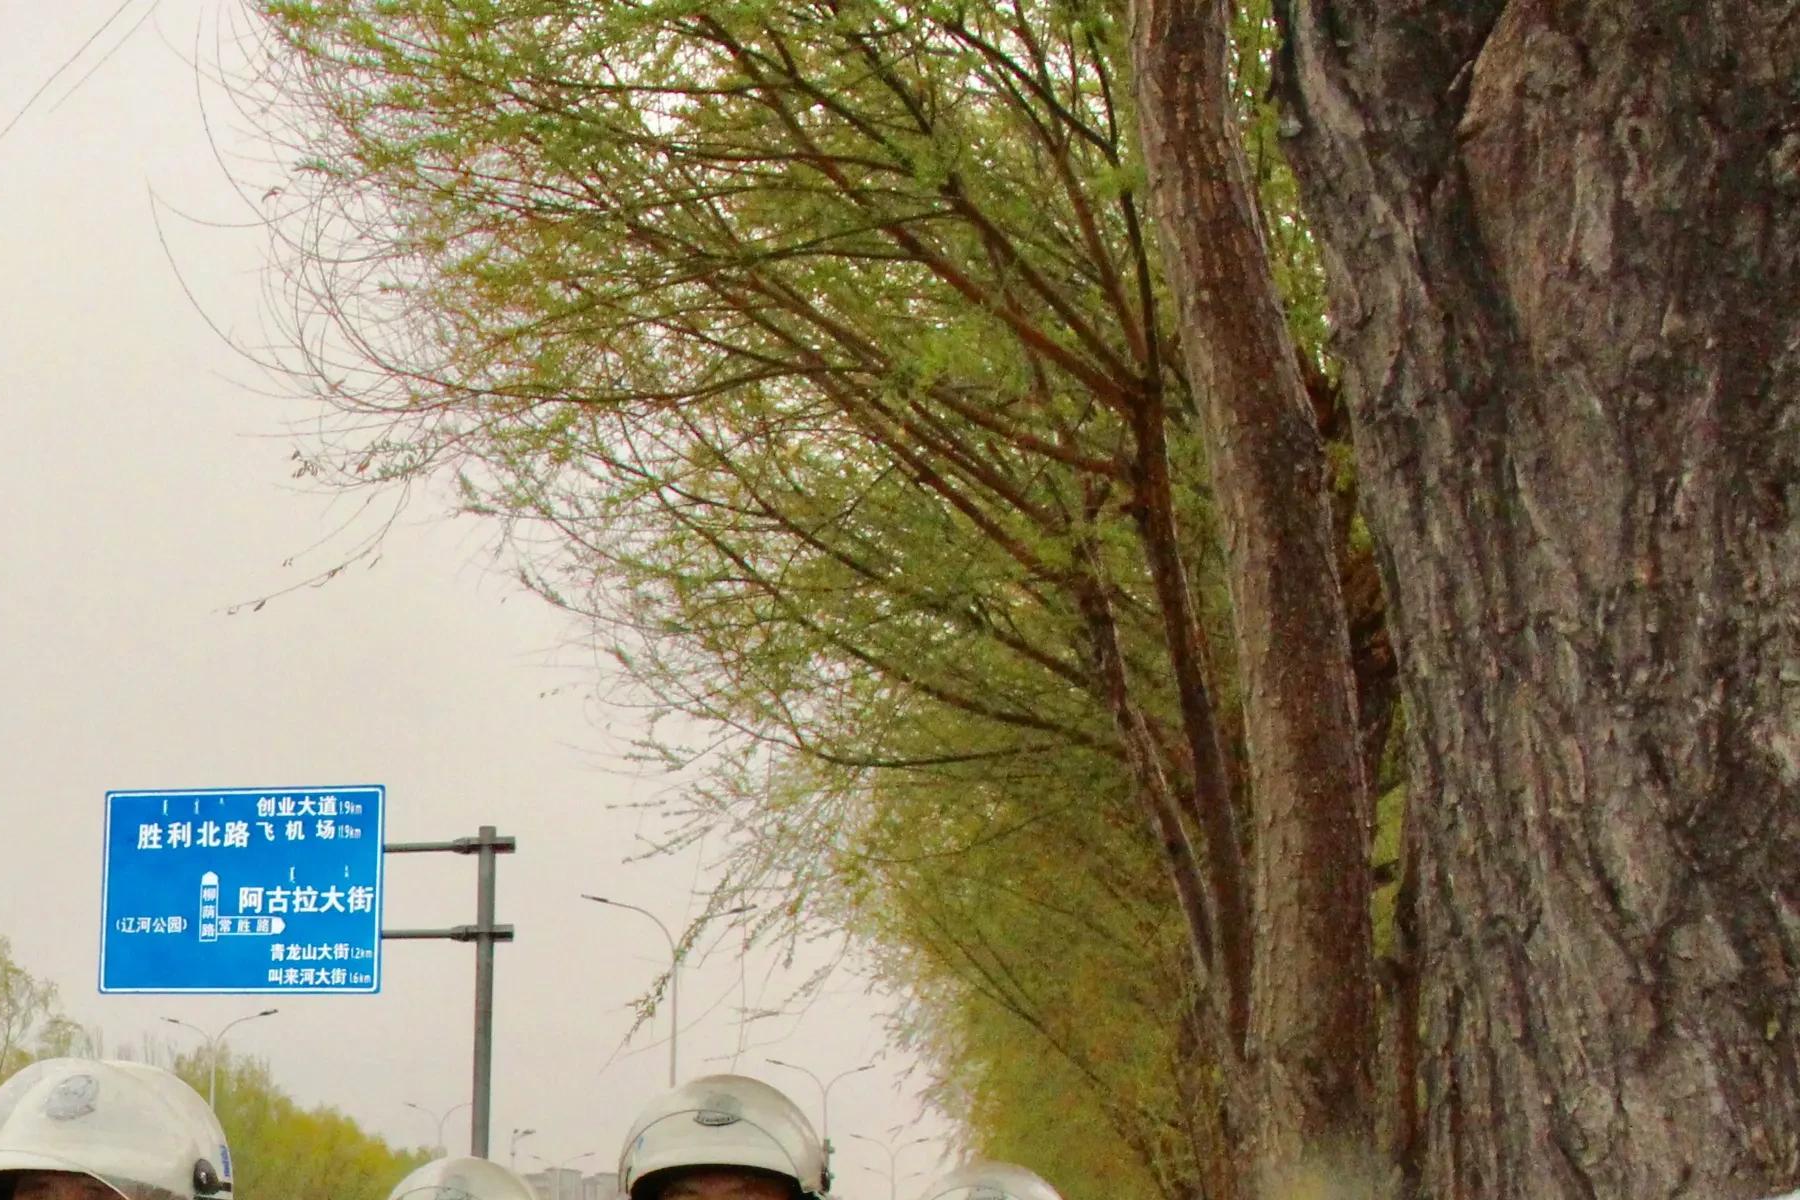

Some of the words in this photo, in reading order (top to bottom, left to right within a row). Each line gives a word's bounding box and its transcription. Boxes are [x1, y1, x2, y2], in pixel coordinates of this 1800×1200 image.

[256, 796, 338, 817] 创业大道
[137, 820, 250, 849] 胜利北路
[256, 819, 335, 841] 飞机场
[238, 885, 374, 914] 阿古拉大街
[270, 943, 349, 961] 青龙山大街
[268, 968, 347, 985] 叫来河大街
